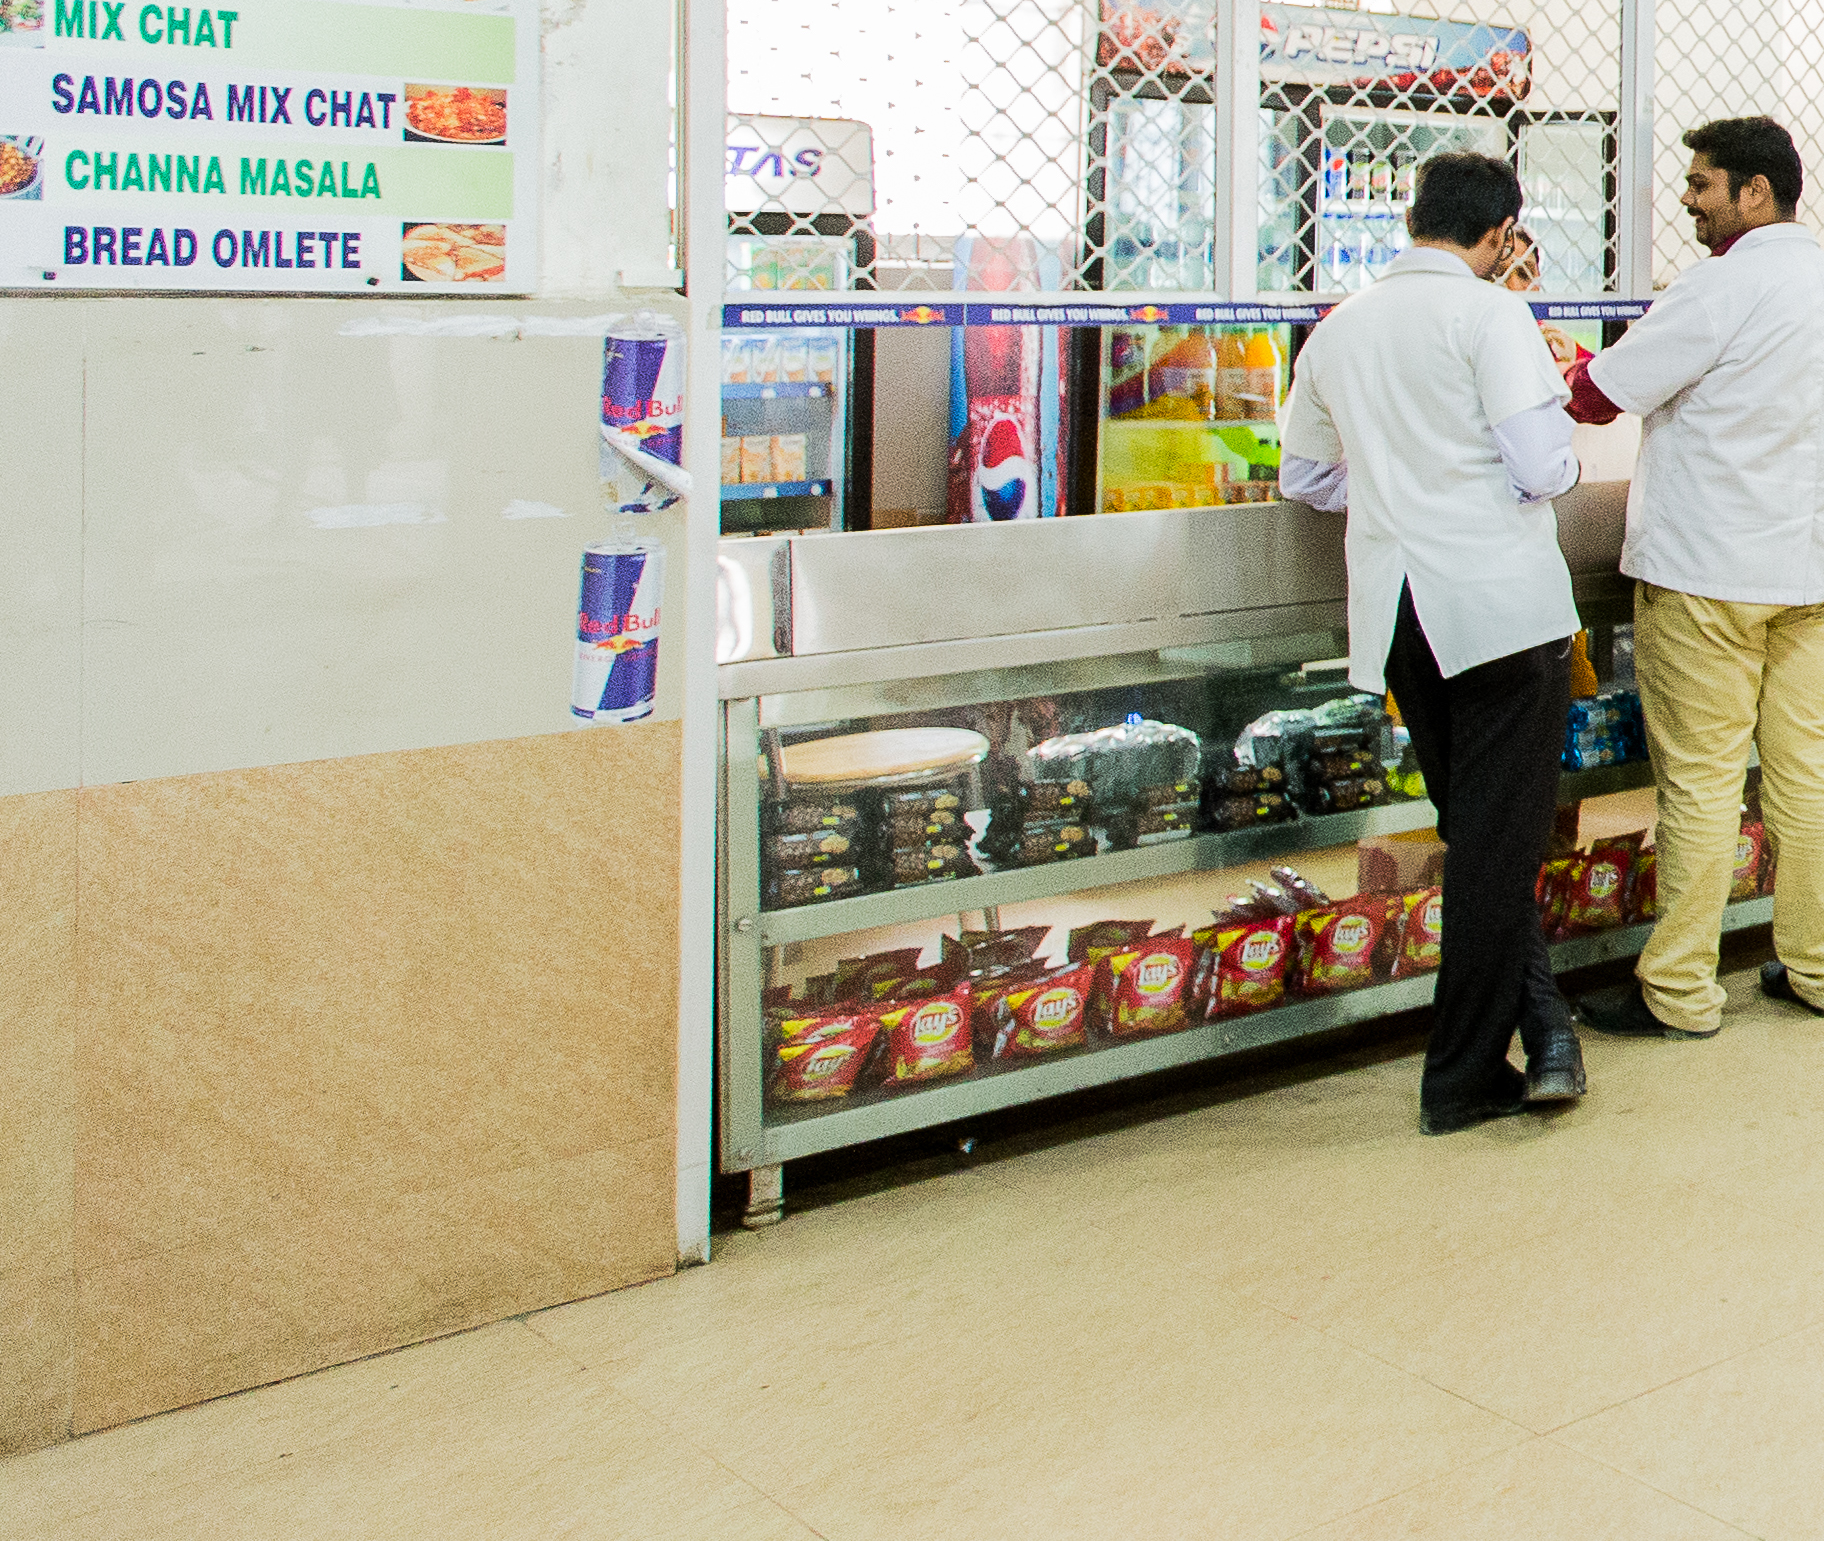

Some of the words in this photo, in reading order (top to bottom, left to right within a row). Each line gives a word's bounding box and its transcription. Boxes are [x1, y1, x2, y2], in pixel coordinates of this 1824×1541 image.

[139, 3, 239, 49] CHAT
[1285, 22, 1441, 72] PEPSI
[52, 73, 214, 121] SAMOSA
[227, 83, 293, 125] MIX
[305, 88, 397, 129] CHAT
[65, 149, 226, 194] CHANNA
[240, 156, 382, 199] MASALA
[64, 225, 197, 267] BREAD
[213, 228, 362, 269] OMLETE
[740, 309, 764, 323] RED
[765, 309, 793, 323] BULL
[793, 309, 827, 323] GIVES
[828, 309, 852, 323] YOU
